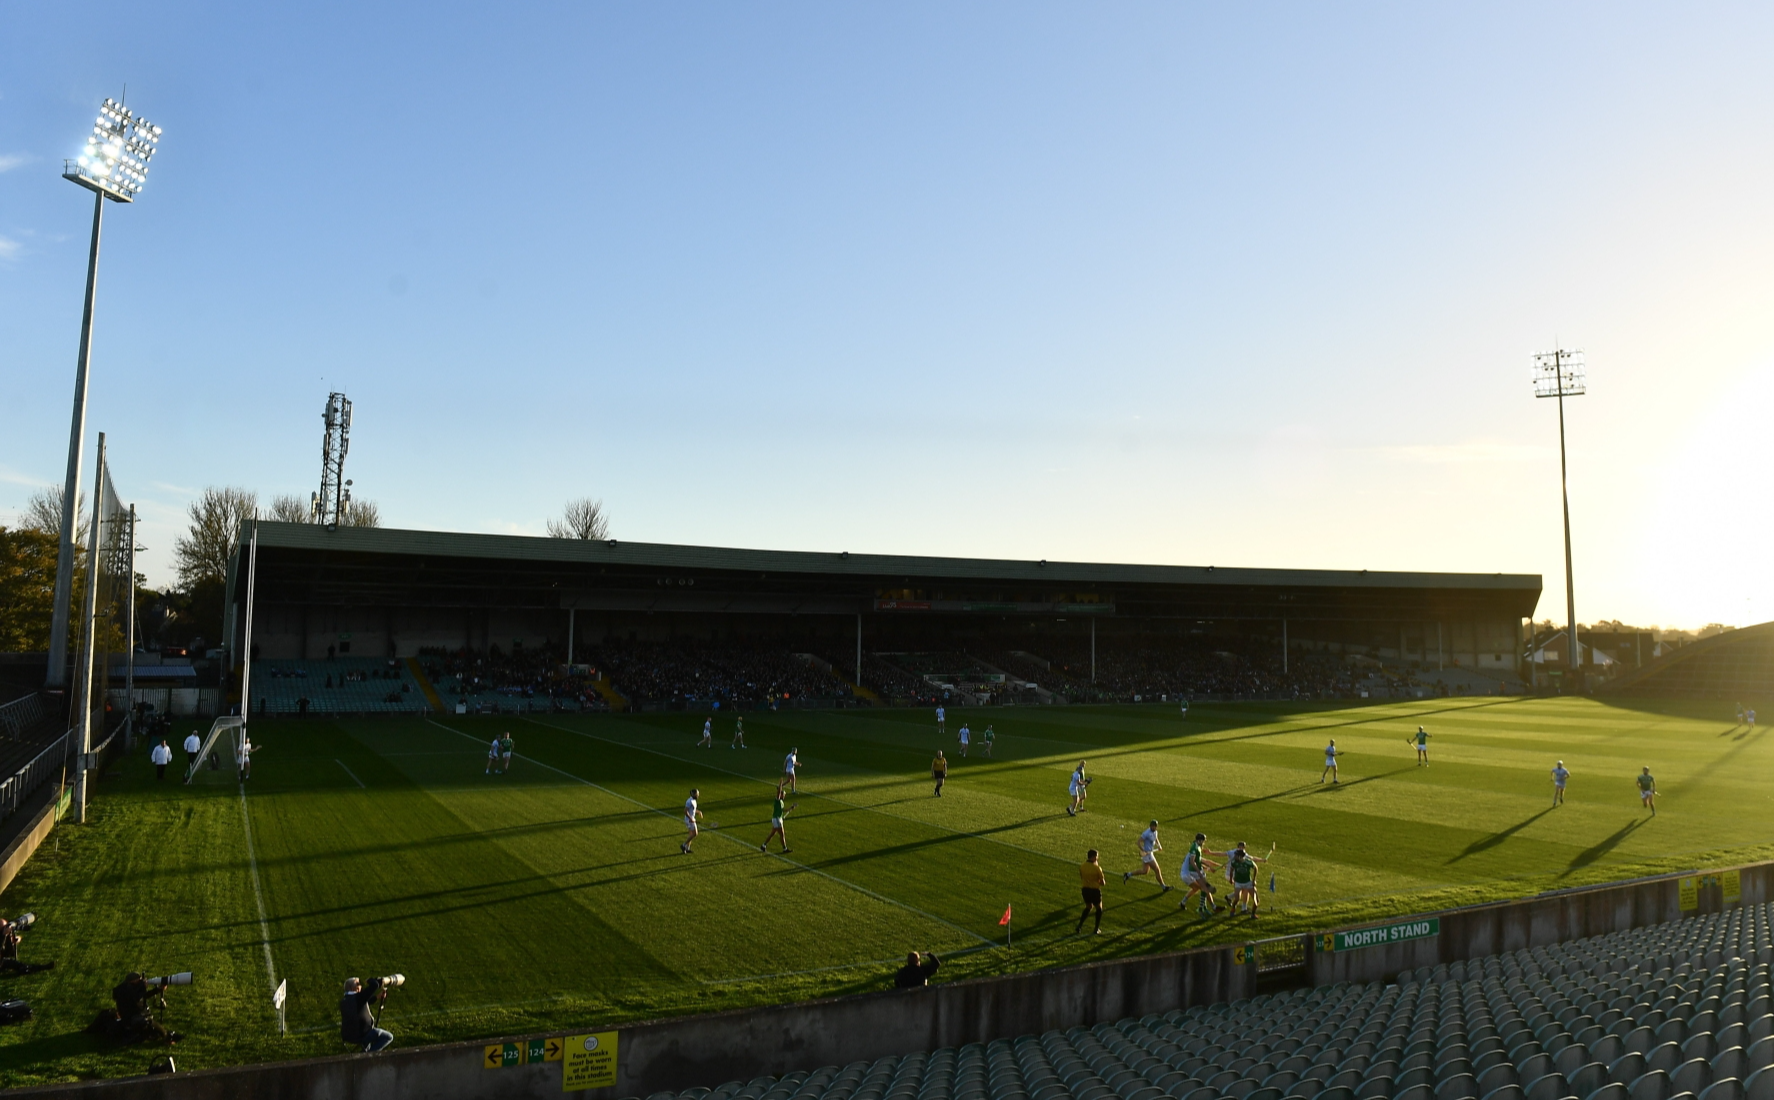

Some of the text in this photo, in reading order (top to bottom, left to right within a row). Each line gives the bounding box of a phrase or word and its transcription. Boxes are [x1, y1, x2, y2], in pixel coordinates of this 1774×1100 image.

[1344, 922, 1430, 948] NORTH STAND
[503, 1050, 519, 1060] 125
[529, 1047, 545, 1057] 124
[572, 1049, 608, 1060] Face masks
[574, 1073, 586, 1081] this
[587, 1071, 613, 1079] stadium
